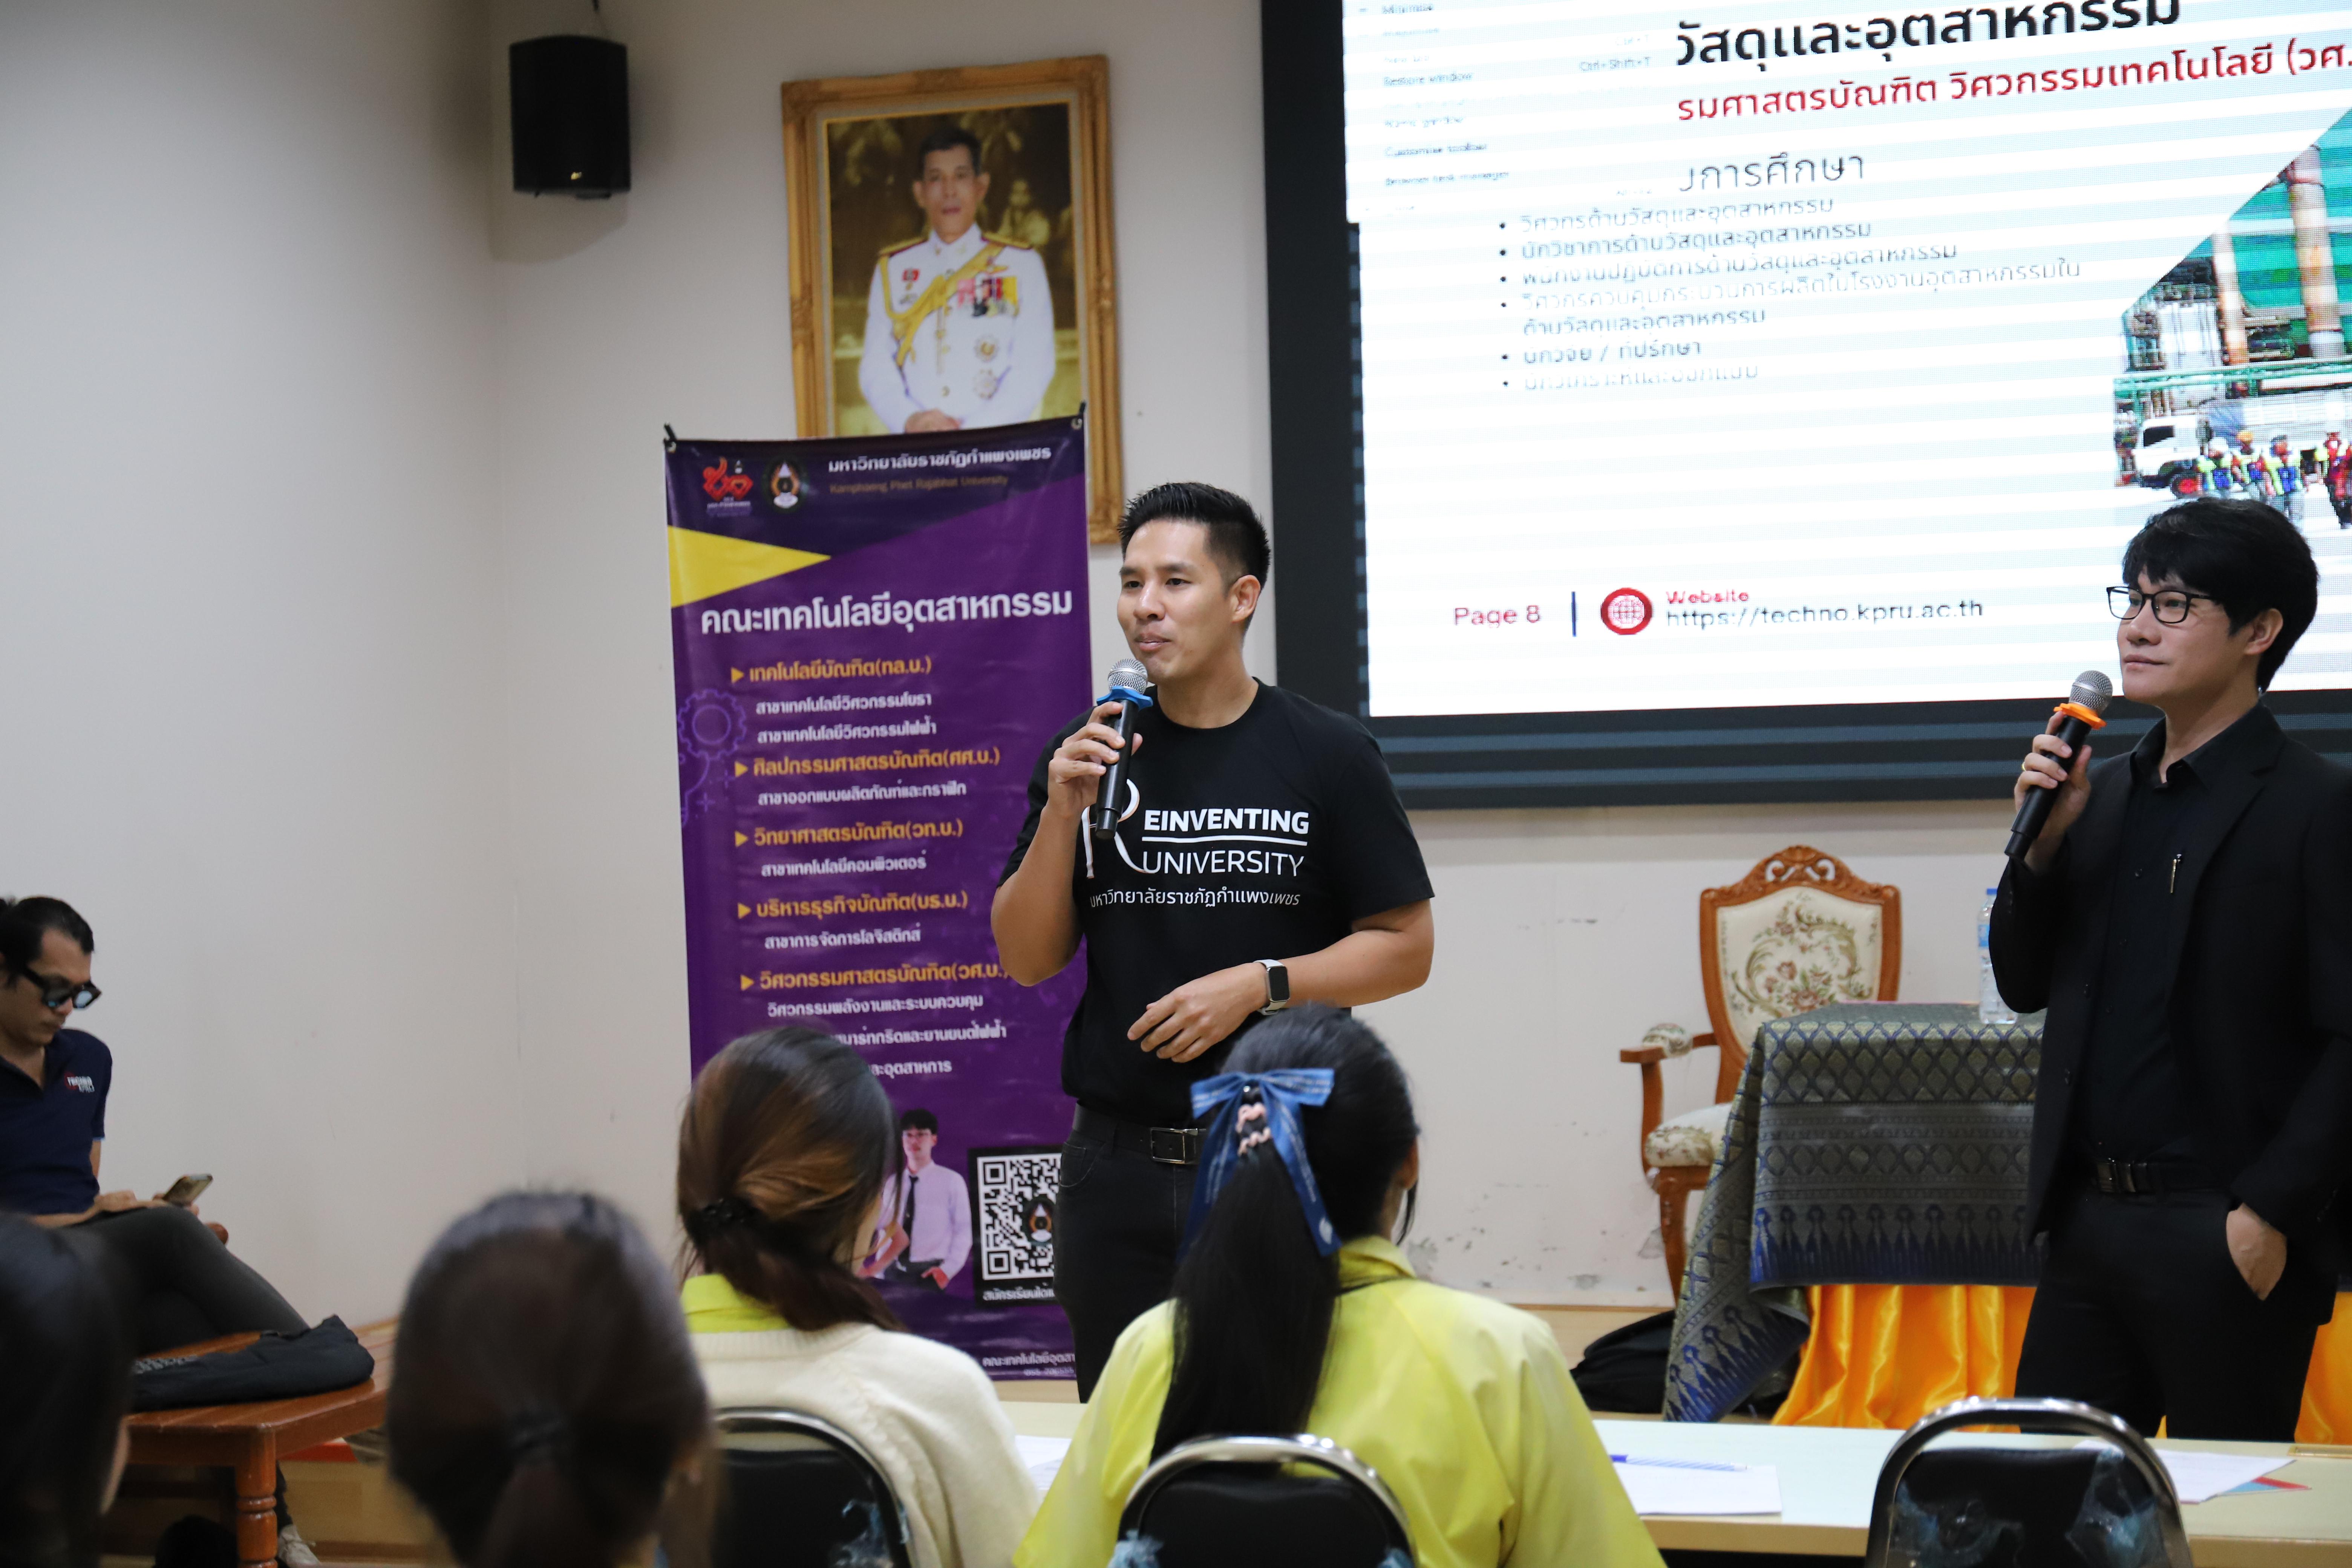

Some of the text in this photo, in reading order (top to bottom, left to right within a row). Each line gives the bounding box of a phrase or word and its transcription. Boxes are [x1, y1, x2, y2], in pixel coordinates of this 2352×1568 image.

[1678, 76, 1936, 121] รมศาสตรบัณฑิต
[1950, 42, 2273, 99] วิศวกรรมเทคโนโลยี
[829, 447, 1052, 472] มหาวิทยาลัยราชภัฏกำแพงเพชร
[701, 590, 1073, 634] คณะเทคโนโลยีอุตสาหกรรม
[1455, 600, 1983, 630] Page 8 https://techno.kpru.ac.th
[1142, 850, 1304, 877] UNIVERSITY
[1090, 886, 1300, 908] มหาวิทยาลัยราชภัฏกำแพงเพชร
